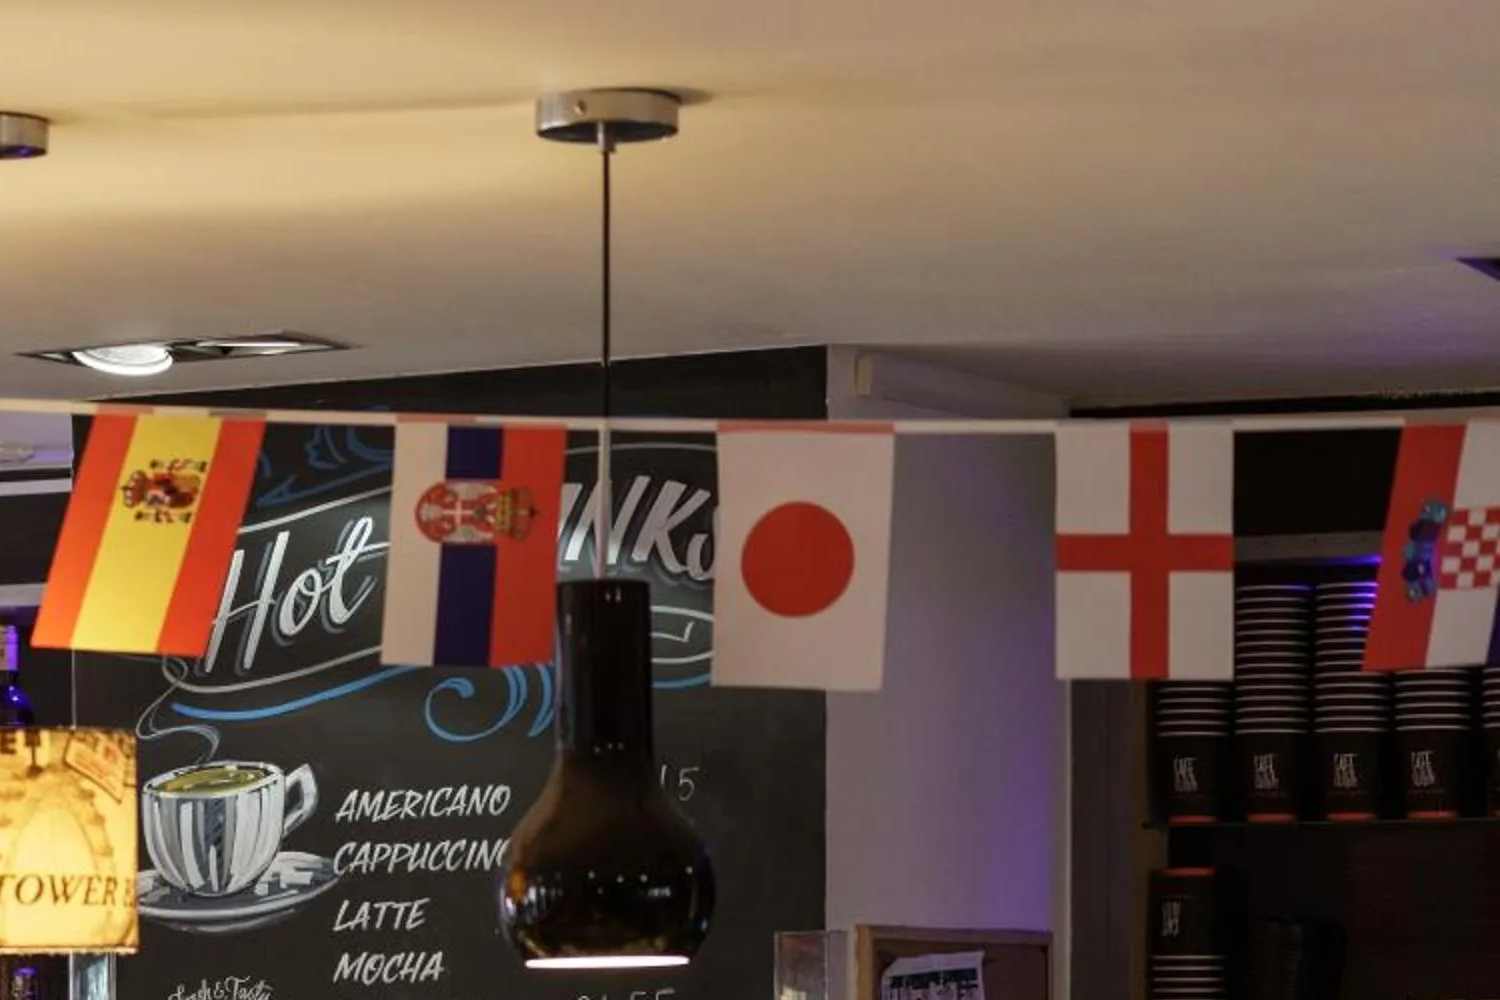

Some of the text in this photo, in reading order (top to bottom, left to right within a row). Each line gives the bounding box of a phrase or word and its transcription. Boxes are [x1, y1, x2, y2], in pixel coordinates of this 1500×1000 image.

[204, 515, 386, 673] Hot
[334, 784, 512, 824] AMERICANO
[332, 897, 431, 932] LATTE
[332, 951, 445, 986] MOCHA
